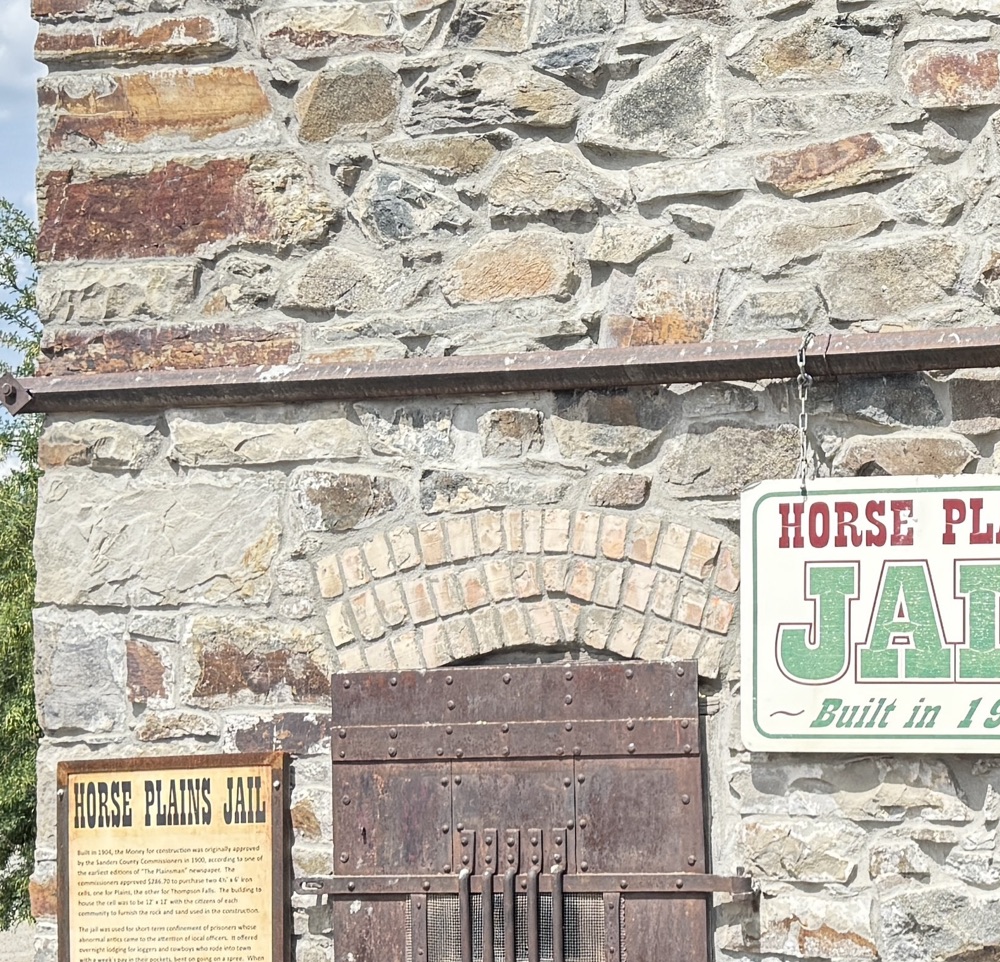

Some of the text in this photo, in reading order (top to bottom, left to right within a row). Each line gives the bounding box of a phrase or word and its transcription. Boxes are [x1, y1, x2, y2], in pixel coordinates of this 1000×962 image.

[778, 499, 914, 549] HORSE
[809, 698, 896, 729] Built
[903, 698, 941, 729] in
[74, 776, 266, 828] HORSE PLAINS JAIL
